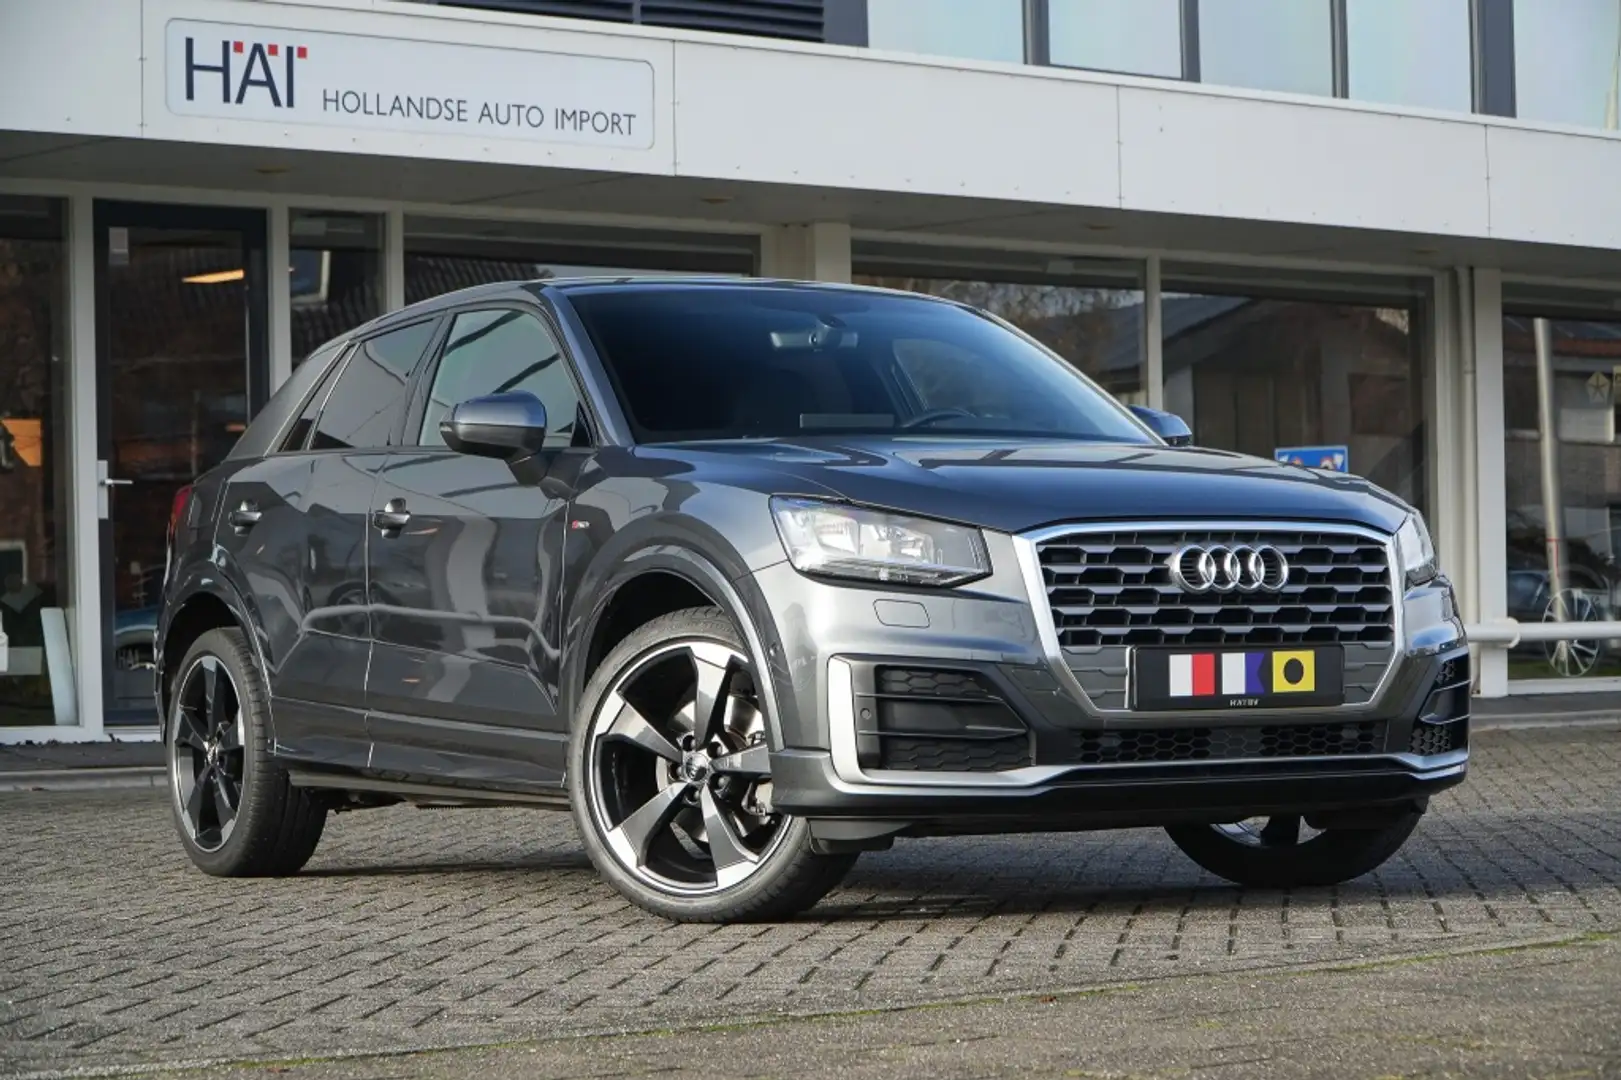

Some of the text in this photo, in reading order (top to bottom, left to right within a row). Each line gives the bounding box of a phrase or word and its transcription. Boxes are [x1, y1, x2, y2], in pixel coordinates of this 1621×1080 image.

[322, 88, 637, 136] HOLLANDSE AUTO IMPORT
